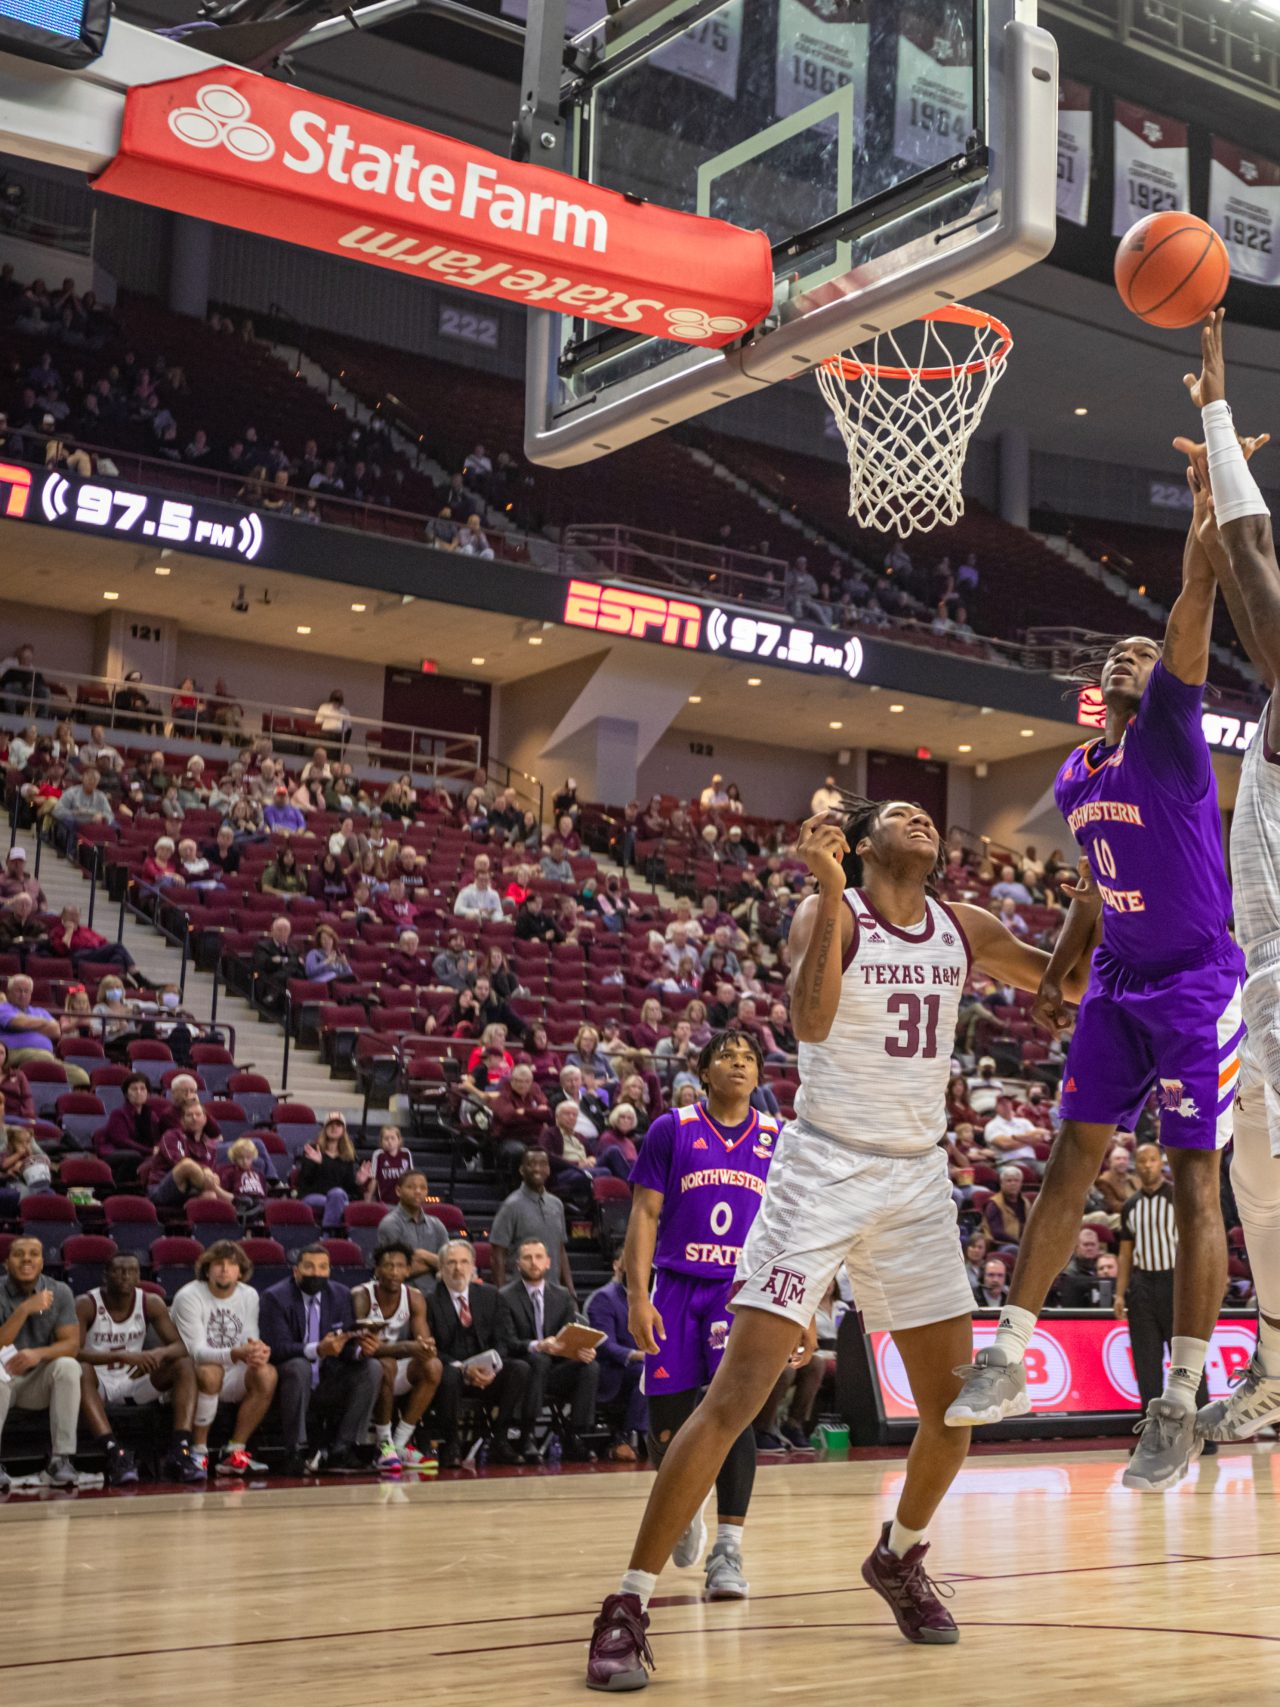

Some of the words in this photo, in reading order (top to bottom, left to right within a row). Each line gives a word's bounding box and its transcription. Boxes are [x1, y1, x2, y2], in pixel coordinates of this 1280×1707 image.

[1223, 214, 1273, 255] 1922
[441, 309, 497, 344] 222
[75, 484, 194, 541] 97.5
[194, 520, 235, 548] FM
[131, 623, 161, 642] 121
[564, 580, 702, 649] ESPN
[730, 617, 814, 664] 97.5
[1092, 836, 1117, 881] 10
[860, 965, 925, 985] TEXAS
[931, 965, 961, 987] A&M
[884, 992, 941, 1059] 31
[709, 1200, 733, 1236] 0
